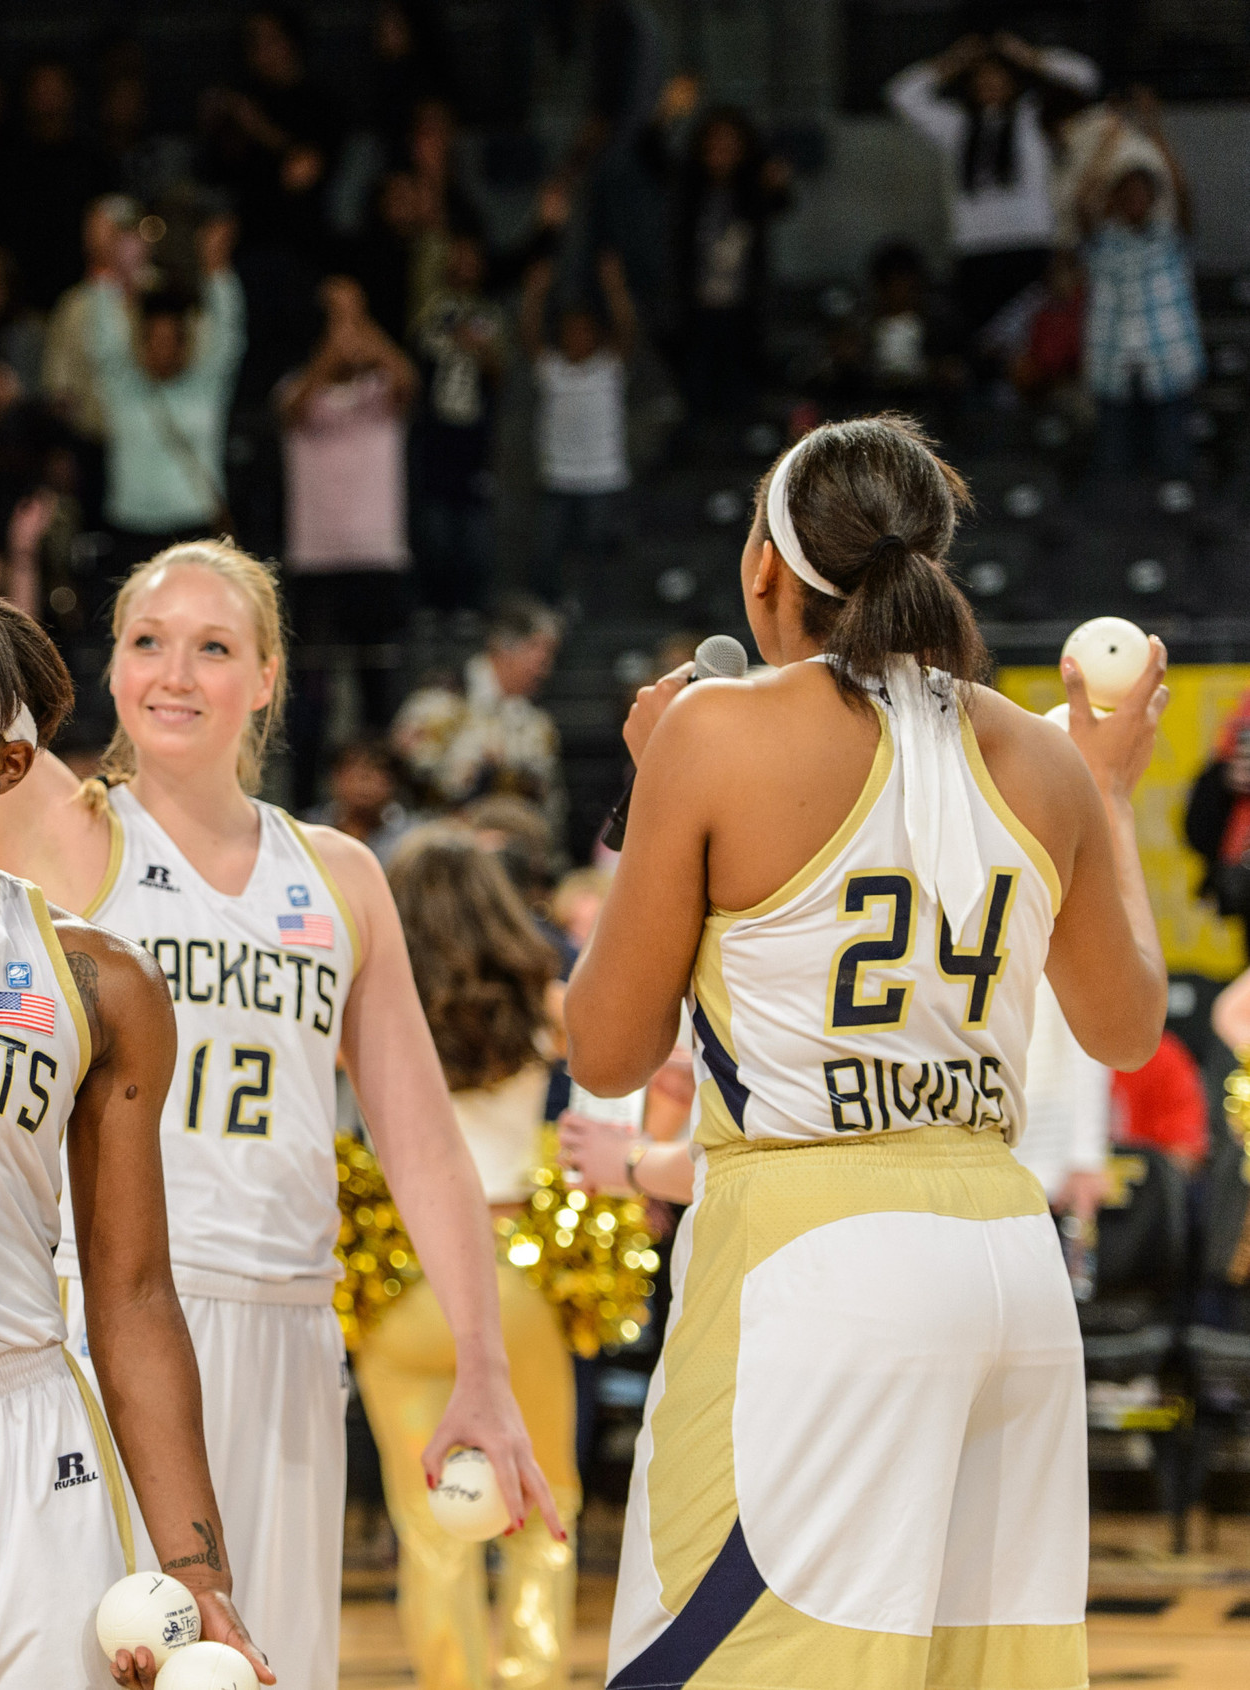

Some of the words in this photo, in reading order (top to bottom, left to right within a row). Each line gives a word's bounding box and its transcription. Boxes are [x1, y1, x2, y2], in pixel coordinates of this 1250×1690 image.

[140, 938, 337, 1036] ACKETS
[824, 866, 1022, 1036] 24
[183, 1038, 276, 1140] 12
[822, 1055, 1005, 1133] BIVINS
[54, 1471, 99, 1491] RUSSELL
[57, 1452, 84, 1480] R
